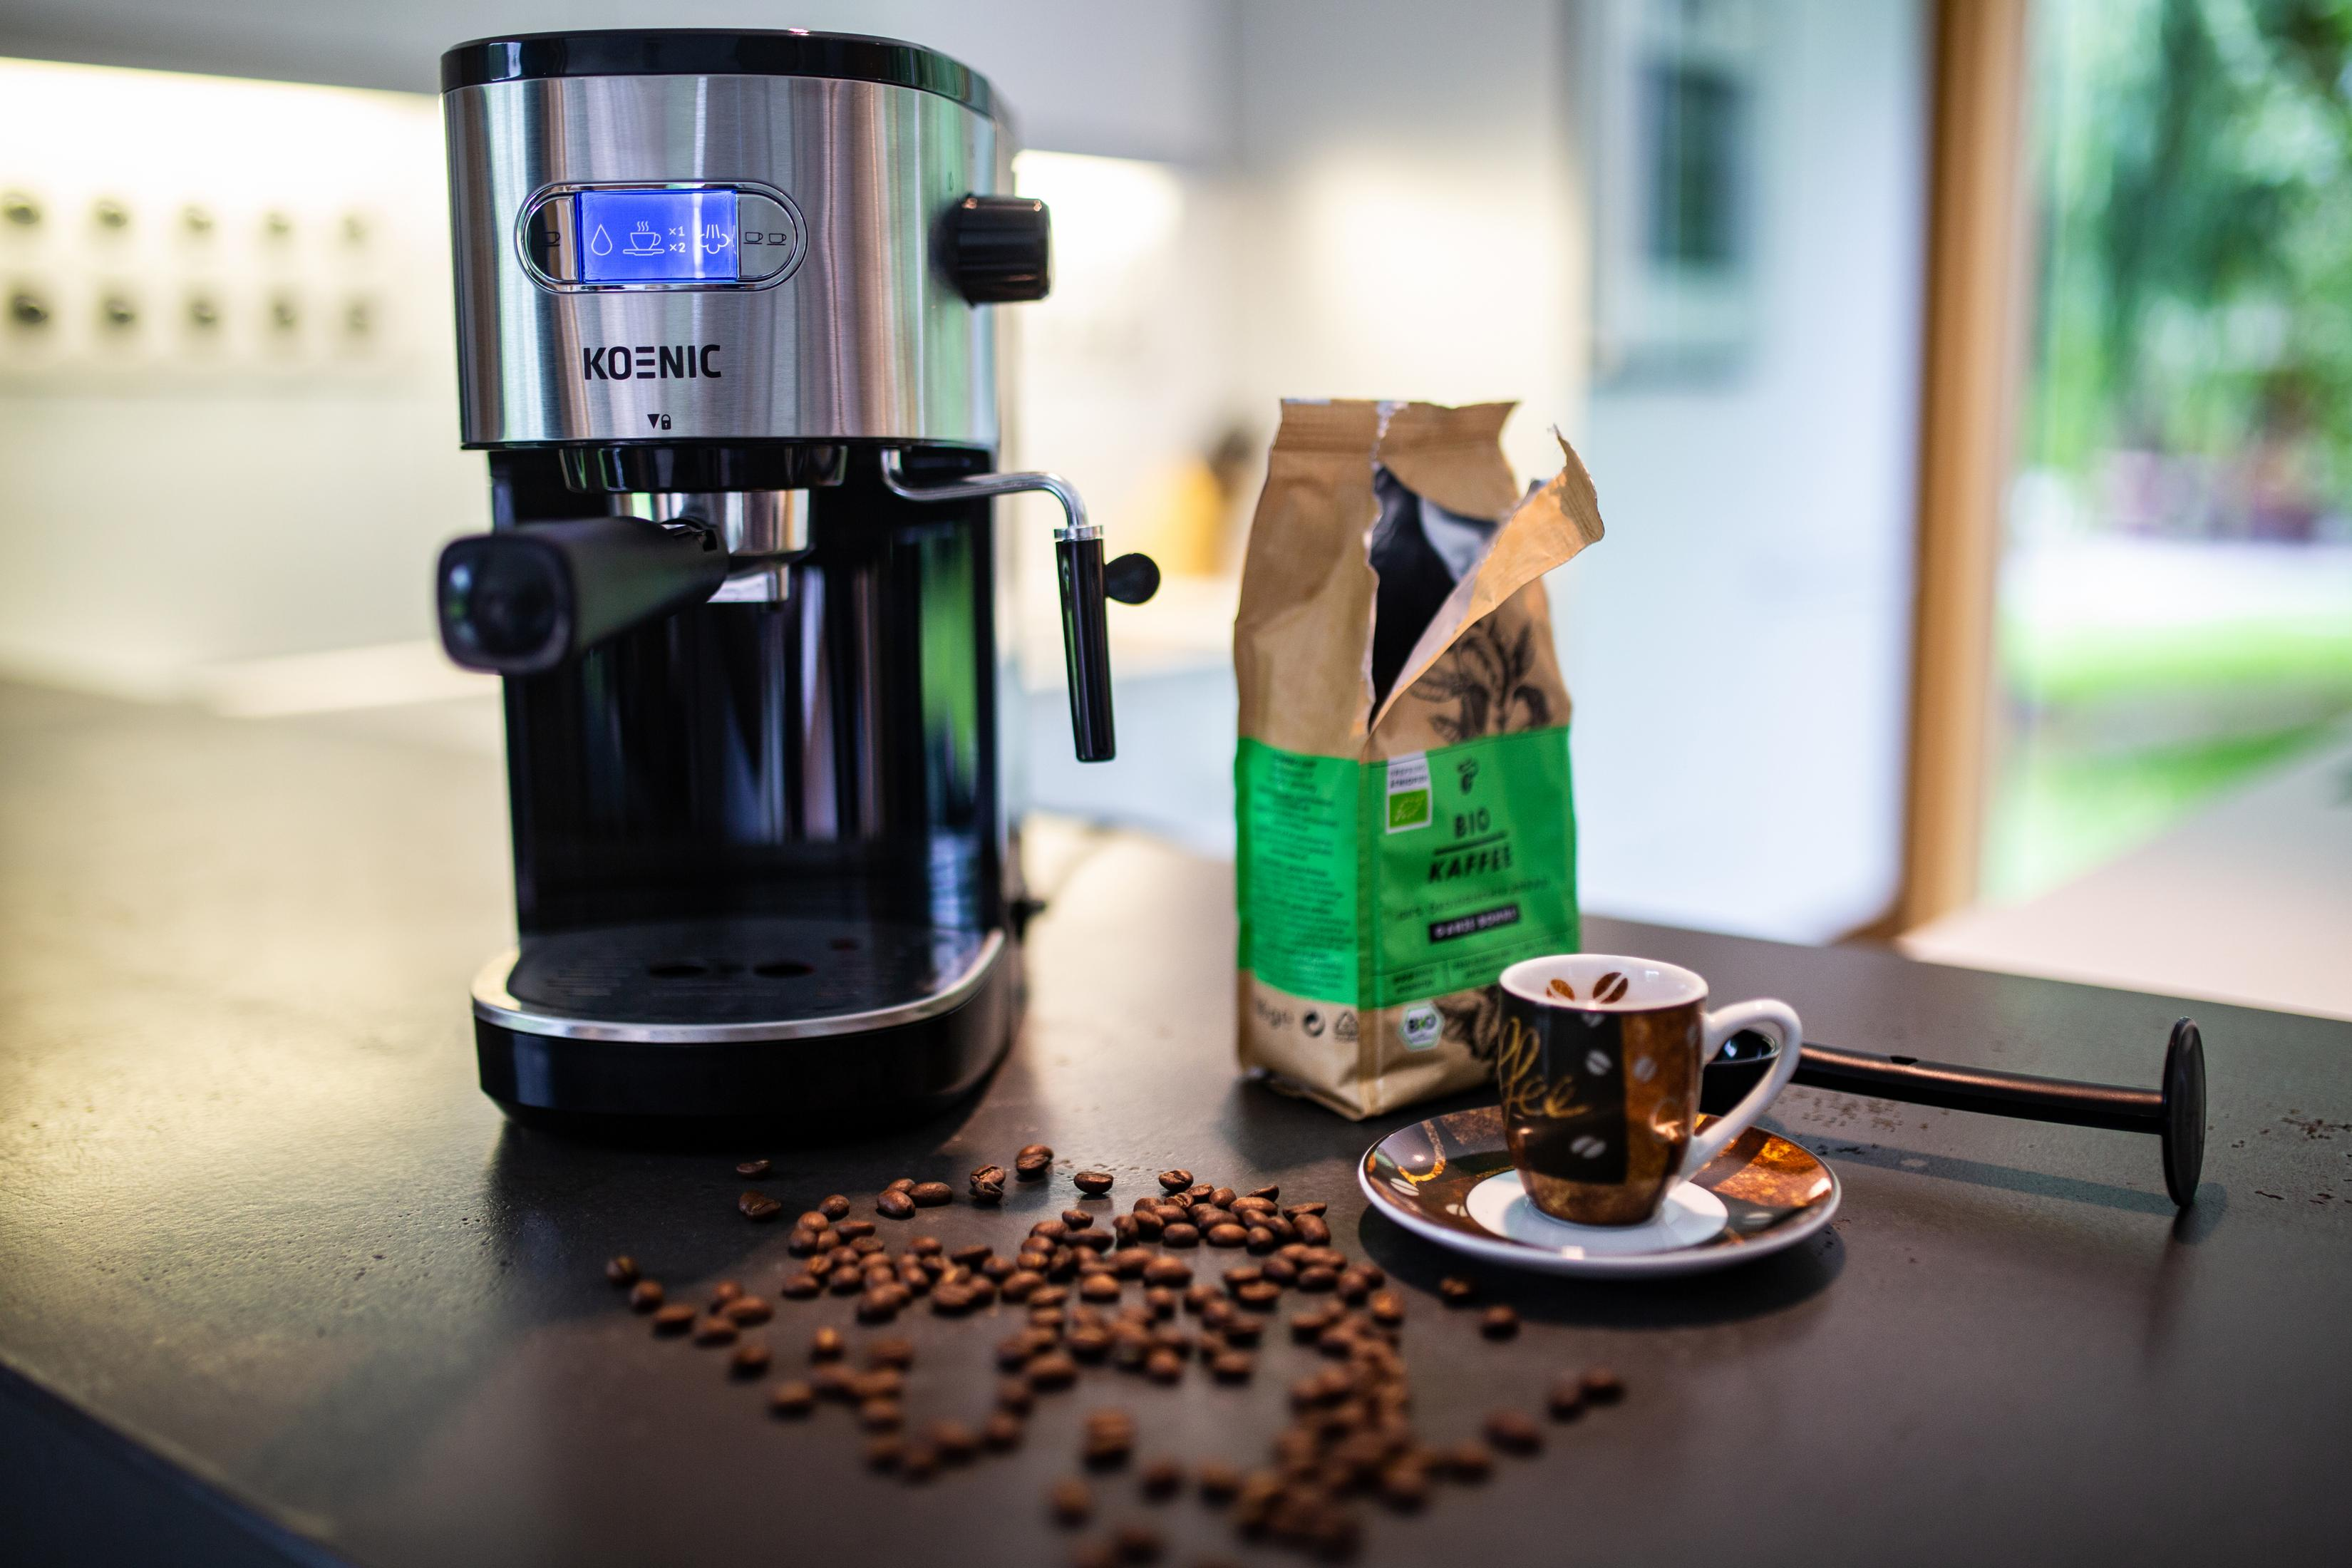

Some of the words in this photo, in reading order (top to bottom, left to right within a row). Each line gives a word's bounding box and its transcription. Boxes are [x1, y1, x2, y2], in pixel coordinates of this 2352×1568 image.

[669, 226, 685, 237] x1
[669, 242, 686, 253] x2
[583, 344, 722, 380] KOENIC
[1455, 806, 1491, 839] BIO
[1428, 842, 1513, 883] KAFFEE
